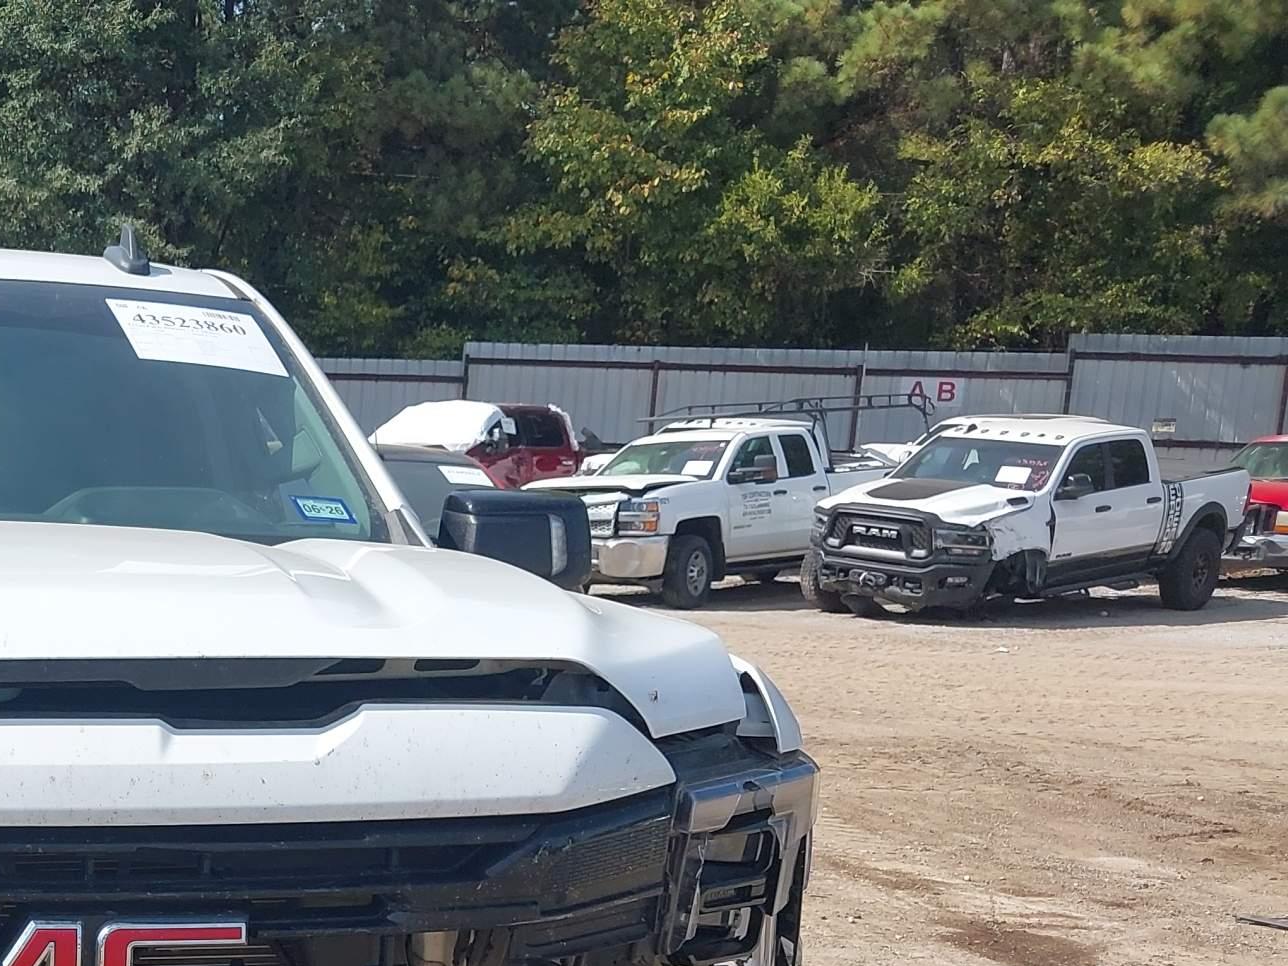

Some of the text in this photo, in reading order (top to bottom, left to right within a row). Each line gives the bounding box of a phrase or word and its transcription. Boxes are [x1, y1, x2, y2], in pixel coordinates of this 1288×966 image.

[133, 313, 247, 336] 43523860
[910, 381, 956, 402] A B
[852, 525, 898, 539] RAM
